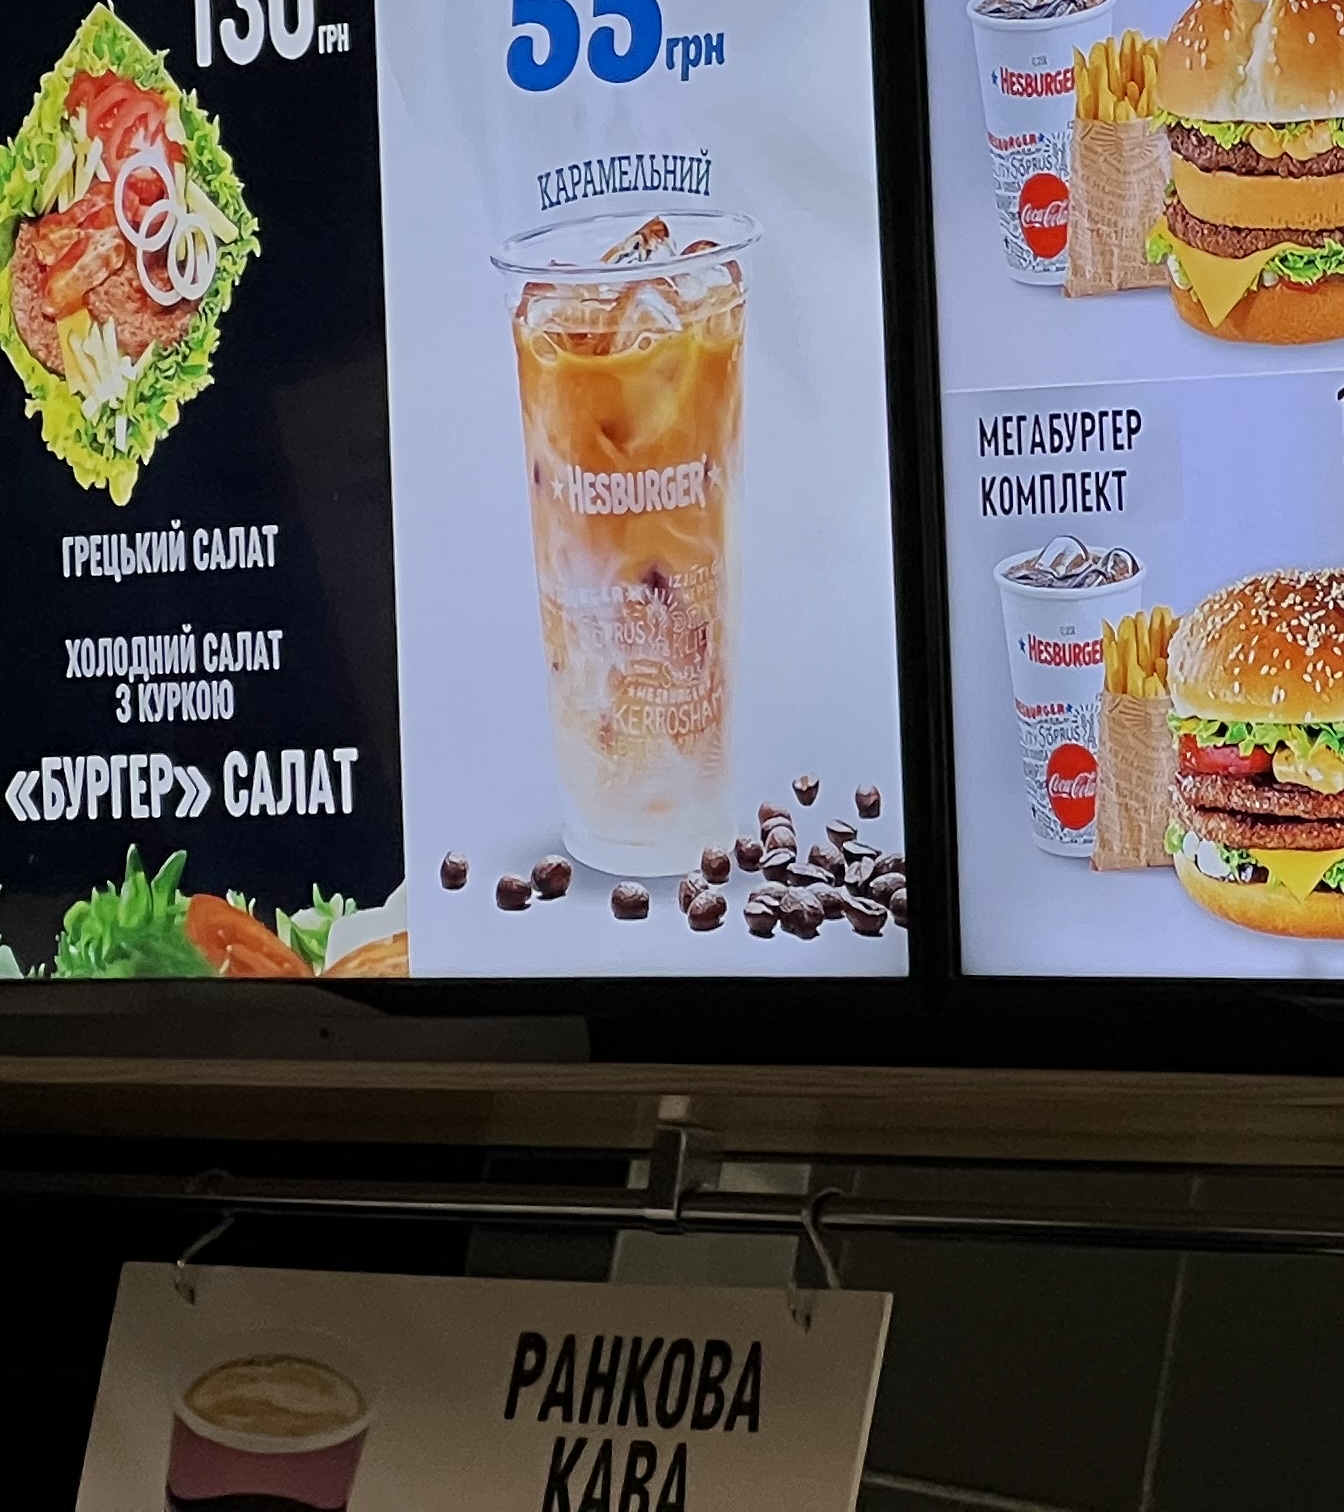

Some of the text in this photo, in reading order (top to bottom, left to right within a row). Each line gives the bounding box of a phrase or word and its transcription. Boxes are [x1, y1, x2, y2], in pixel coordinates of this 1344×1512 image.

[537, 148, 712, 211] КАРАМЕЛЬНИЙ
[978, 409, 1142, 458] МЕГАБУРГЕР
[568, 460, 706, 515] HESBURGER
[981, 470, 1127, 517] КОМПЛЕКТ
[62, 519, 279, 583] ГРЕЦЬКИЙ САЛАТ
[64, 623, 283, 684] ХОЛОДНИЙ САЛАТ
[137, 678, 235, 723] КУРКОЮ
[4, 747, 359, 822] «БУРГЕР» САЛАТ
[503, 1331, 763, 1433] РАНКОВА
[541, 1436, 687, 1512] КАВА
